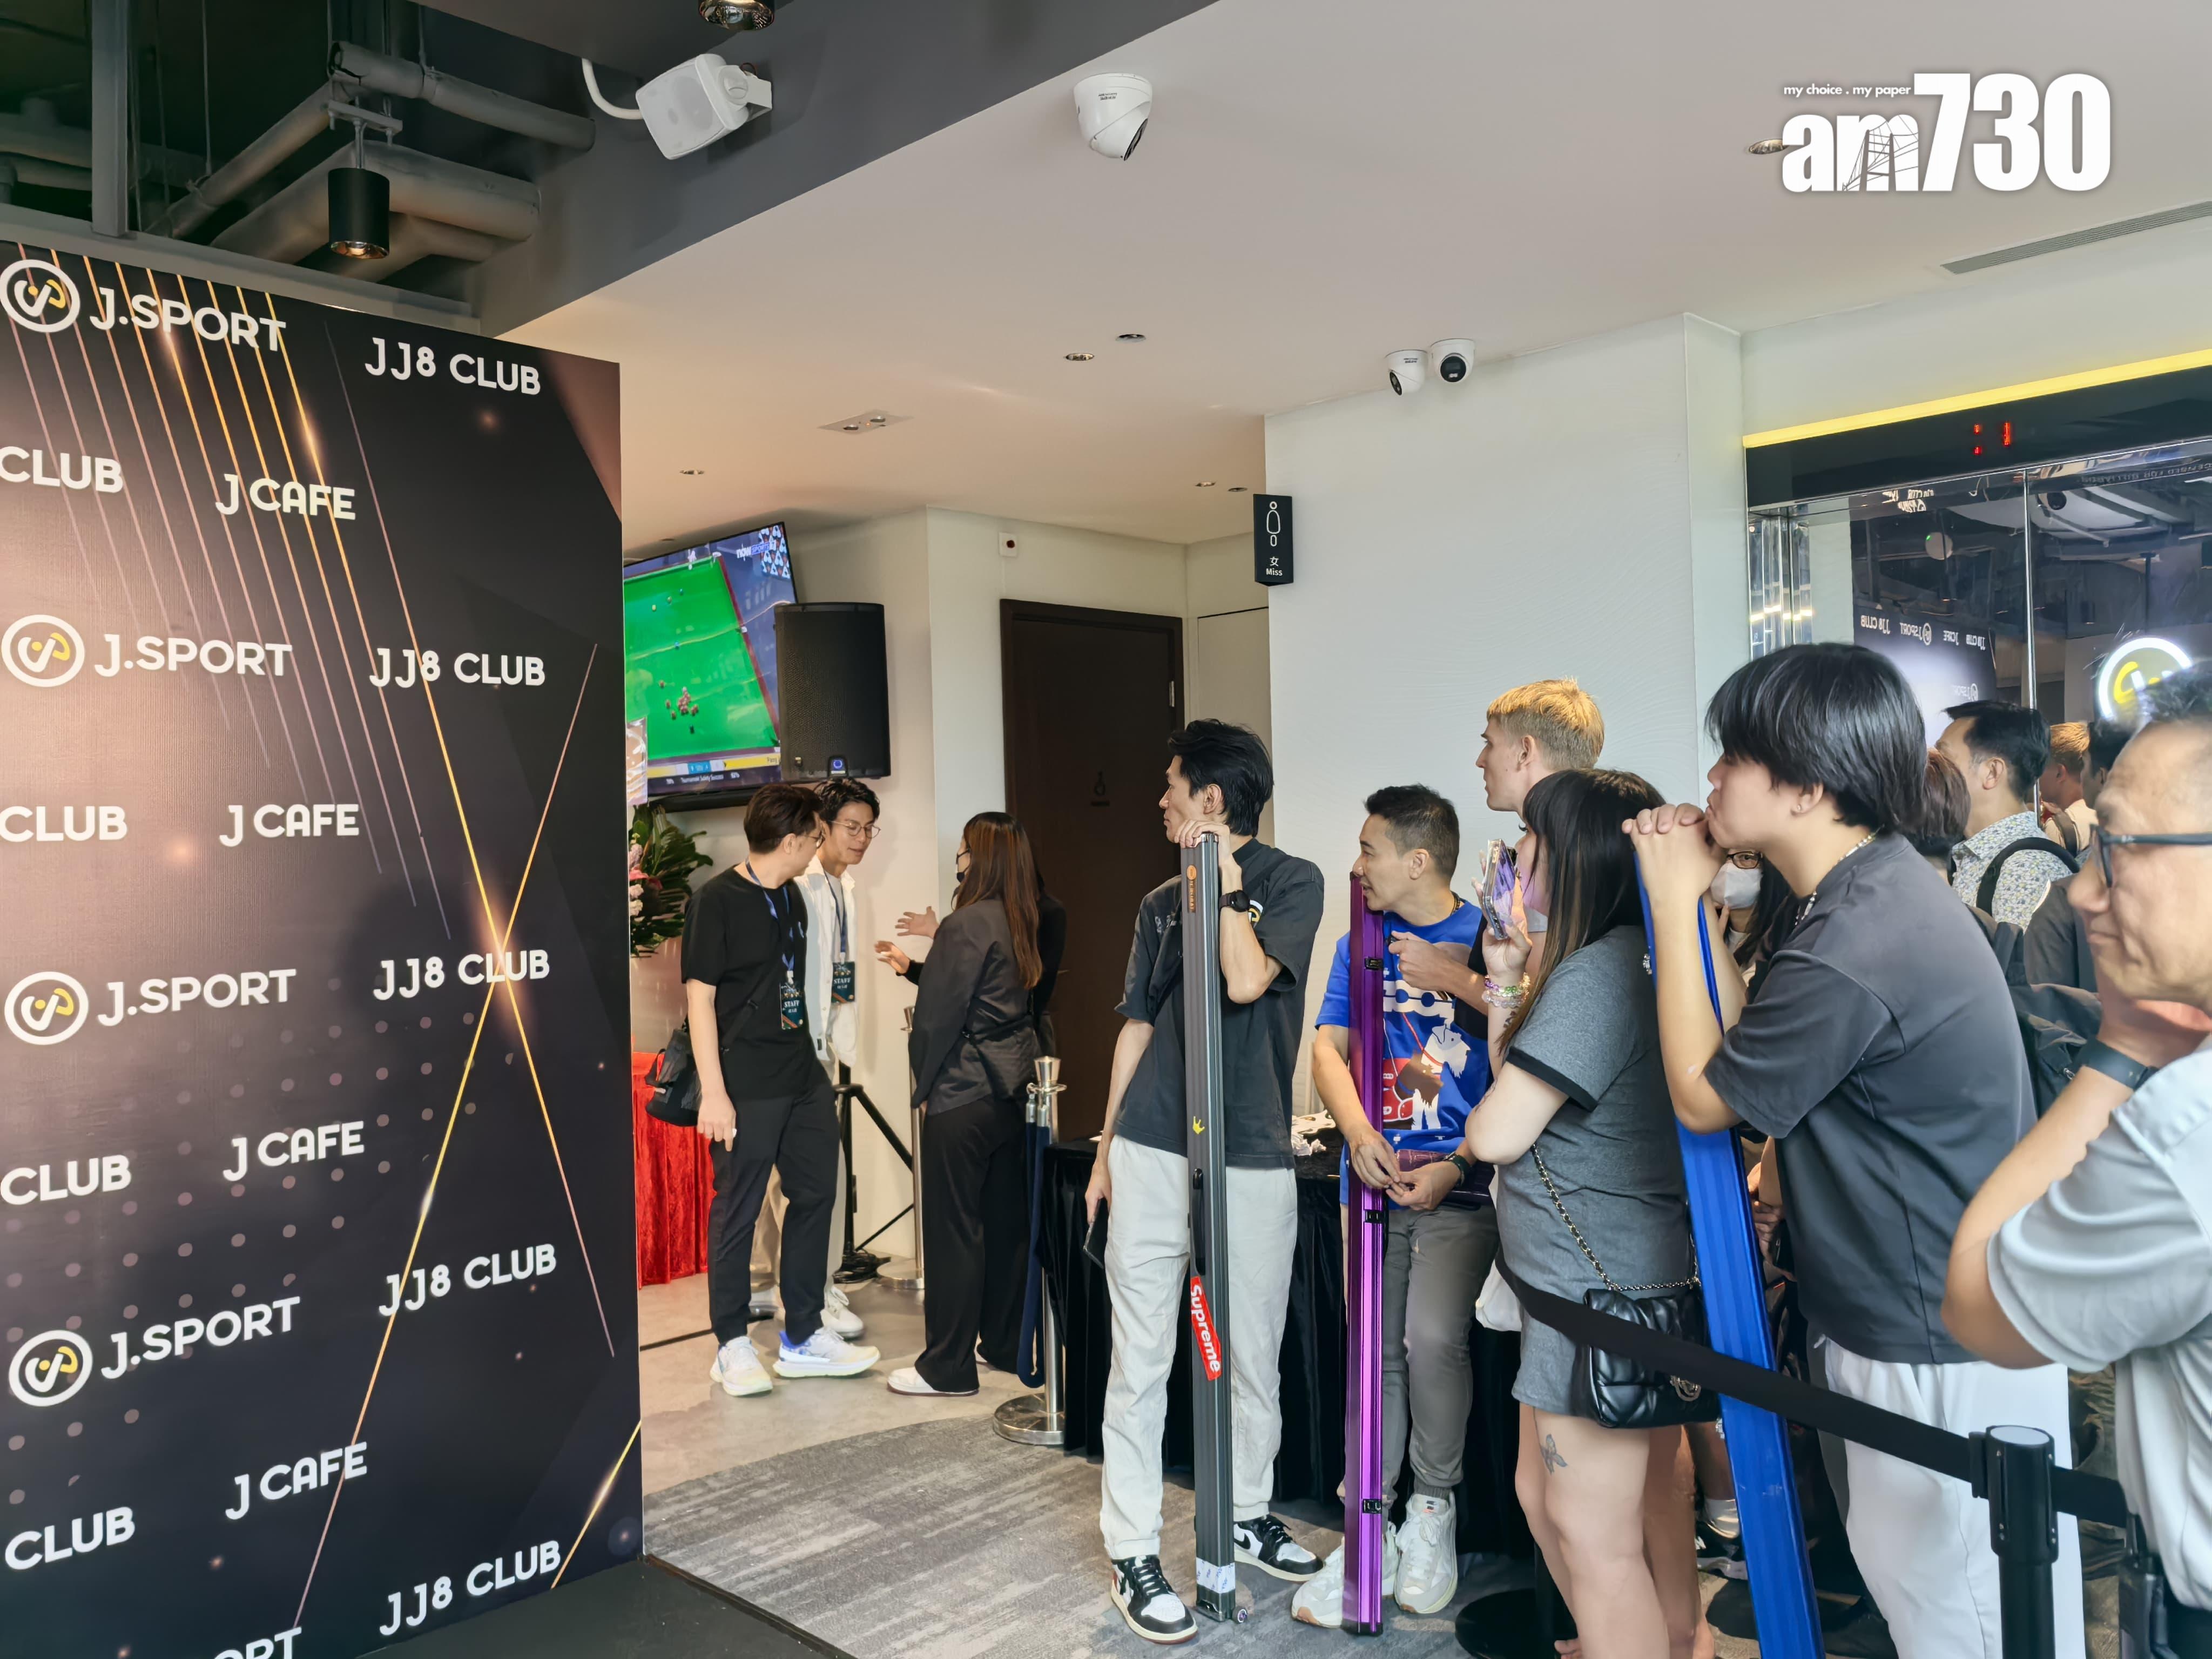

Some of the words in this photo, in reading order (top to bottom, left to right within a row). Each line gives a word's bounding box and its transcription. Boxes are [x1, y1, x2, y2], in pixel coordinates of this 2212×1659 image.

[90, 288, 286, 352] J.SPORT
[365, 338, 436, 381] JJ8
[449, 353, 541, 396] CLUB
[0, 446, 123, 493] CLUB
[1266, 568, 1283, 576] Miss
[1270, 556, 1279, 567] 女
[94, 633, 293, 677] J.SPORT
[369, 648, 441, 689] JJ8
[454, 652, 545, 686] CLUB
[0, 806, 127, 842] CLUB
[97, 969, 296, 1027] J.SPORT
[373, 956, 445, 1001] JJ8
[457, 949, 550, 985] CLUB
[0, 1155, 132, 1205] CLUB
[379, 1265, 450, 1317] JJ8
[464, 1243, 557, 1289] CLUB
[101, 1297, 301, 1380] J.SPORT
[1191, 1284, 1221, 1373] Supreme
[4, 1506, 135, 1570] CLUB
[380, 1576, 452, 1636] JJ8
[466, 1540, 561, 1598] CLUB
